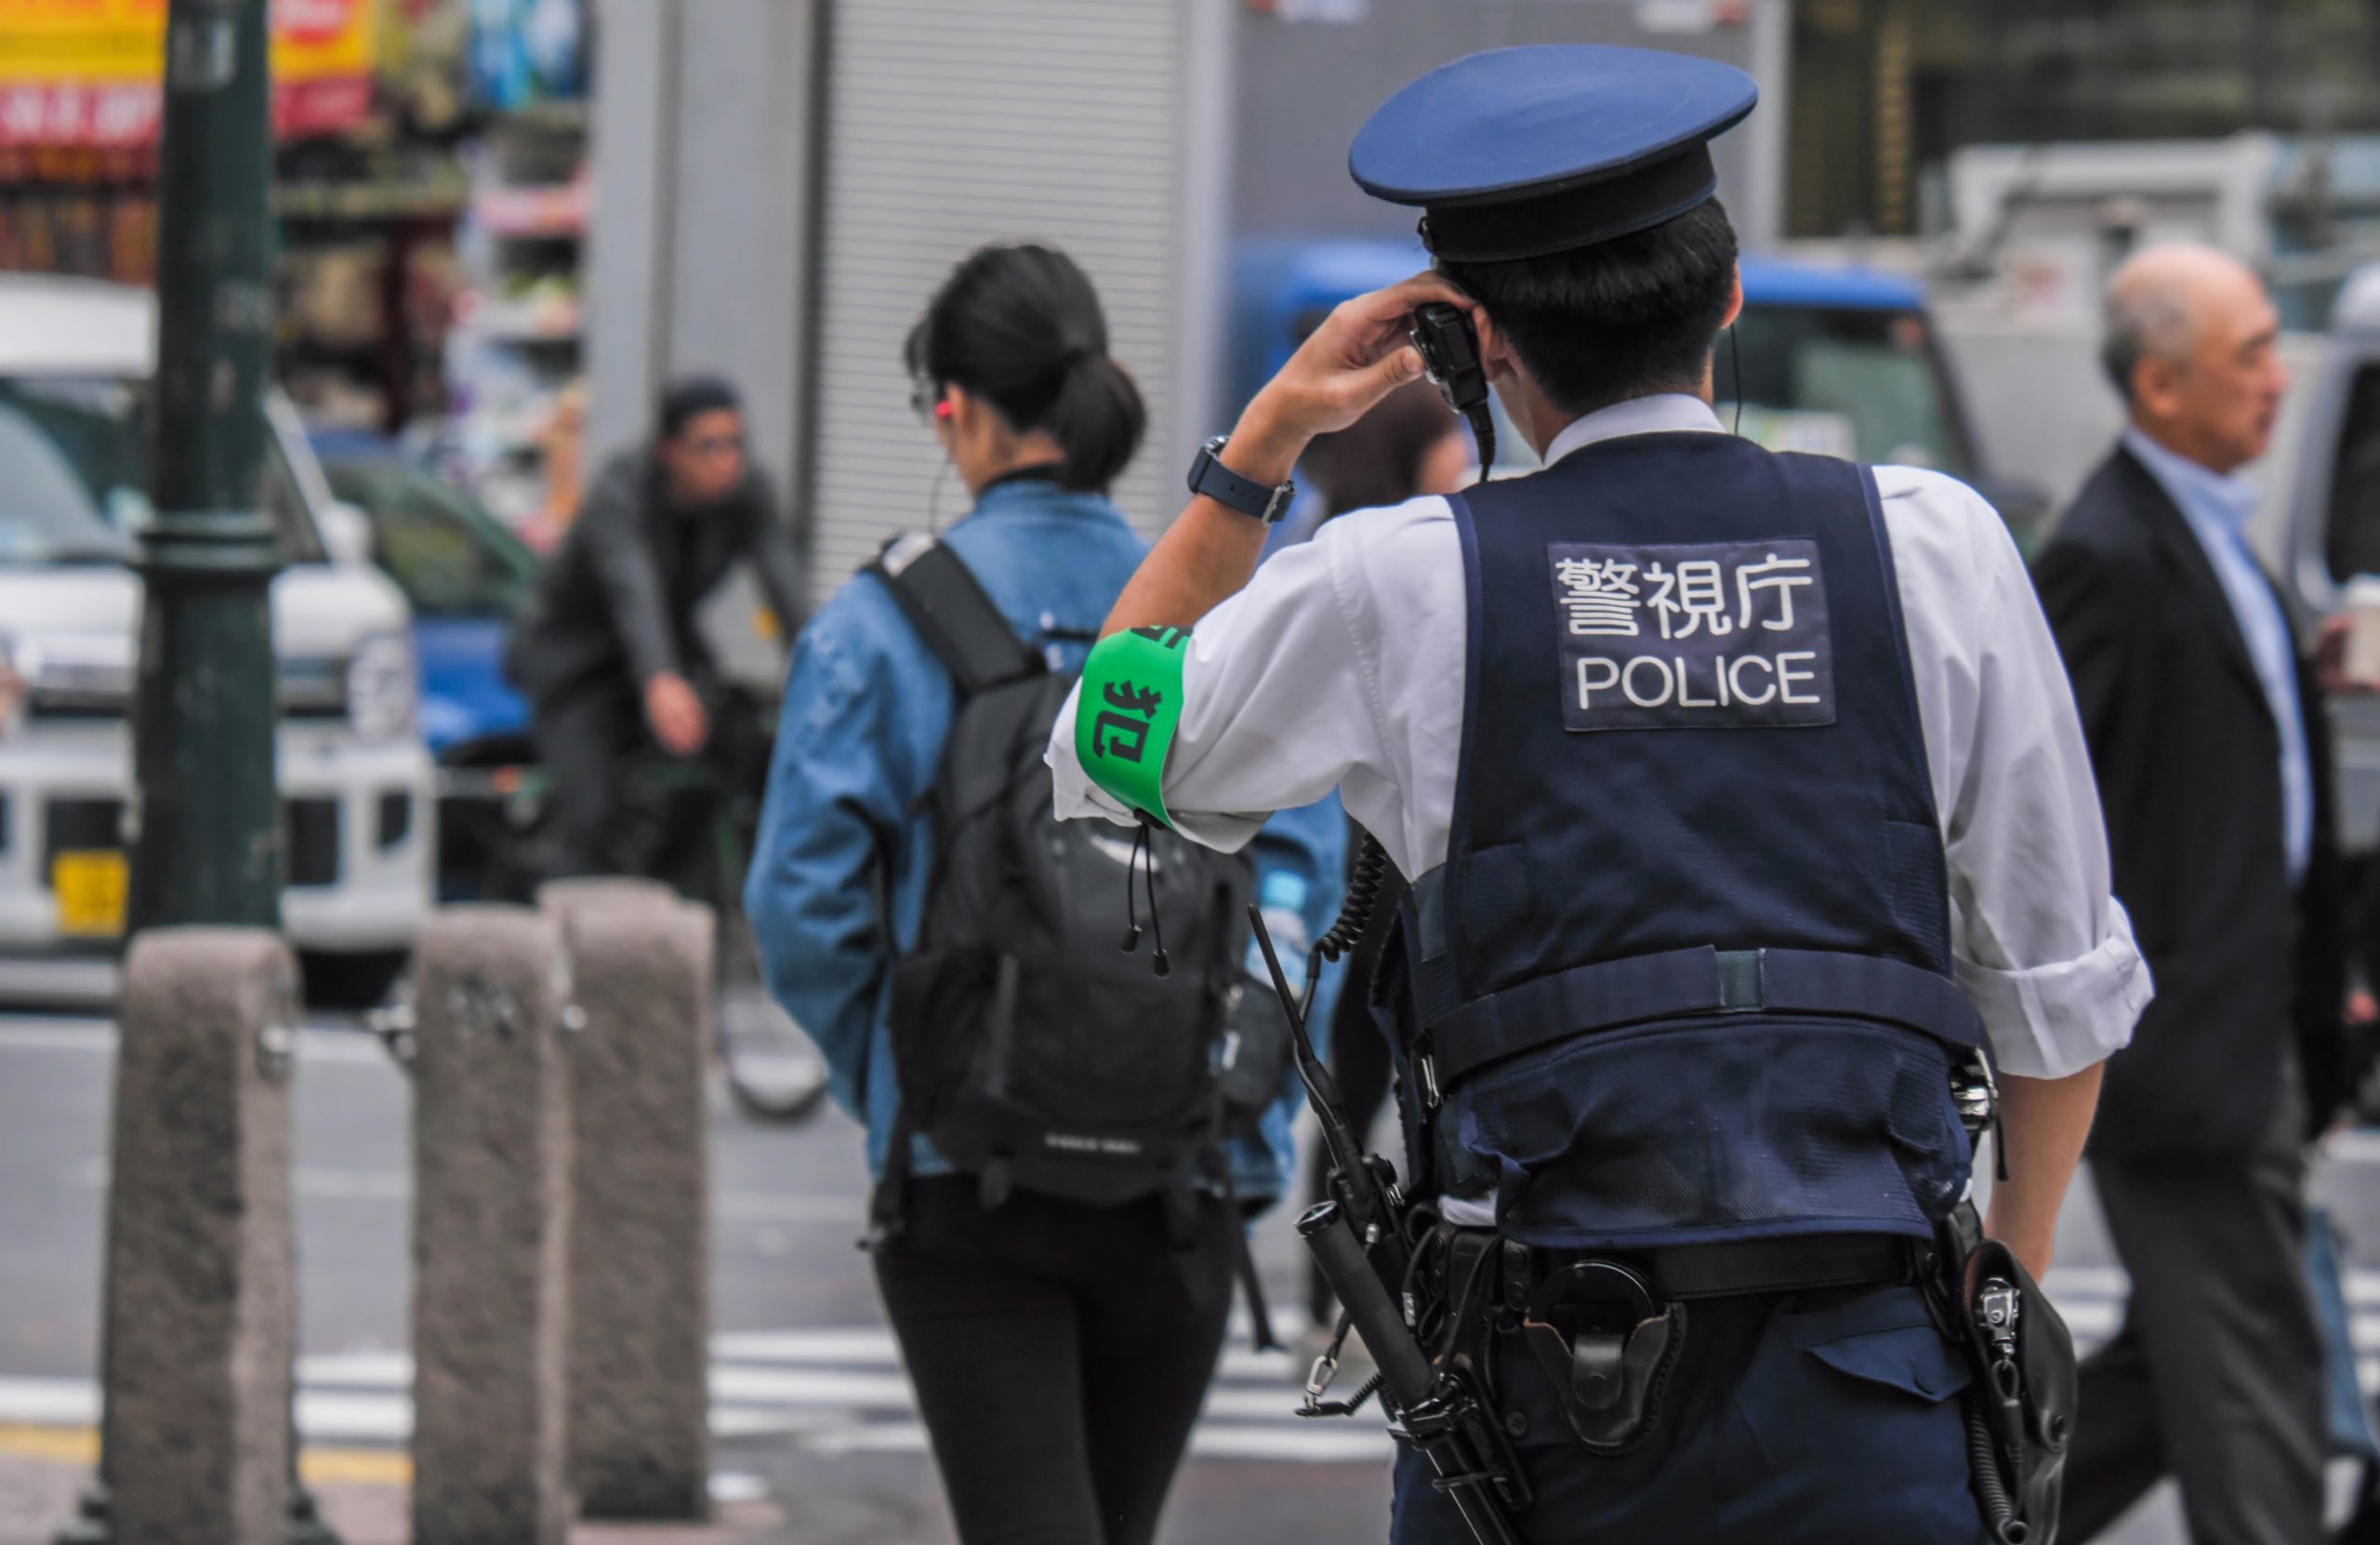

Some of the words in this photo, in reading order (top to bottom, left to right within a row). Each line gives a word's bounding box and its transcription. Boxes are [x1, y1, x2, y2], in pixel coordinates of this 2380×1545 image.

[1555, 553, 1813, 639] 警視庁
[1577, 651, 1820, 709] POLICE
